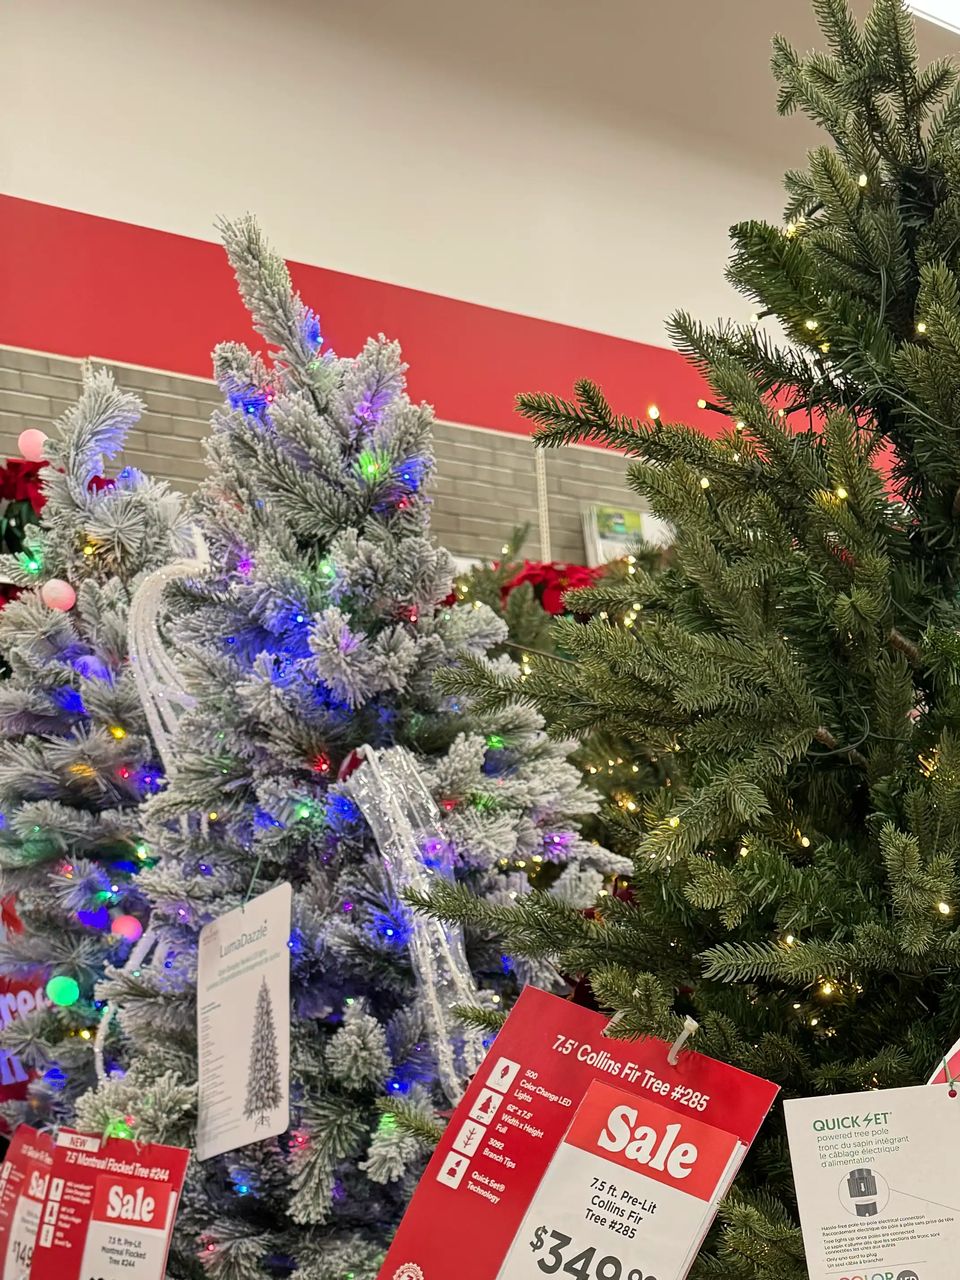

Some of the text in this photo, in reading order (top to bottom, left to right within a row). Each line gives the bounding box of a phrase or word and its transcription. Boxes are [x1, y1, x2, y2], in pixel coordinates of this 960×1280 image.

[525, 1070, 538, 1079] 500
[552, 1035, 710, 1111] 7.5' Collins Fir Tree #285
[514, 1089, 532, 1102] Lights
[520, 1079, 571, 1106] Color Change LED
[496, 1124, 508, 1134] Full
[502, 1113, 543, 1138] Width Height
[813, 1116, 860, 1131] QUICK
[70, 1137, 88, 1147] NEW
[597, 1105, 698, 1179] Sale
[817, 1132, 852, 1143] powered
[872, 1128, 889, 1137] pole
[853, 1140, 873, 1148] sapin
[483, 1148, 516, 1169] Branch Tips
[829, 1149, 859, 1158] câblage
[861, 1146, 900, 1155] électrique
[78, 1153, 107, 1169] Montreal
[108, 1159, 134, 1174] Flocked
[134, 1163, 150, 1177] Tree
[150, 1169, 170, 1182] #244
[472, 1171, 489, 1186] Quick
[28, 1170, 50, 1200] Sal
[467, 1181, 500, 1204] Technology
[590, 1178, 657, 1214] 7.5 ft. Pre-Lit
[106, 1185, 155, 1222] Sale
[591, 1195, 643, 1225] Collins Fir
[585, 1208, 637, 1239] Tree #285
